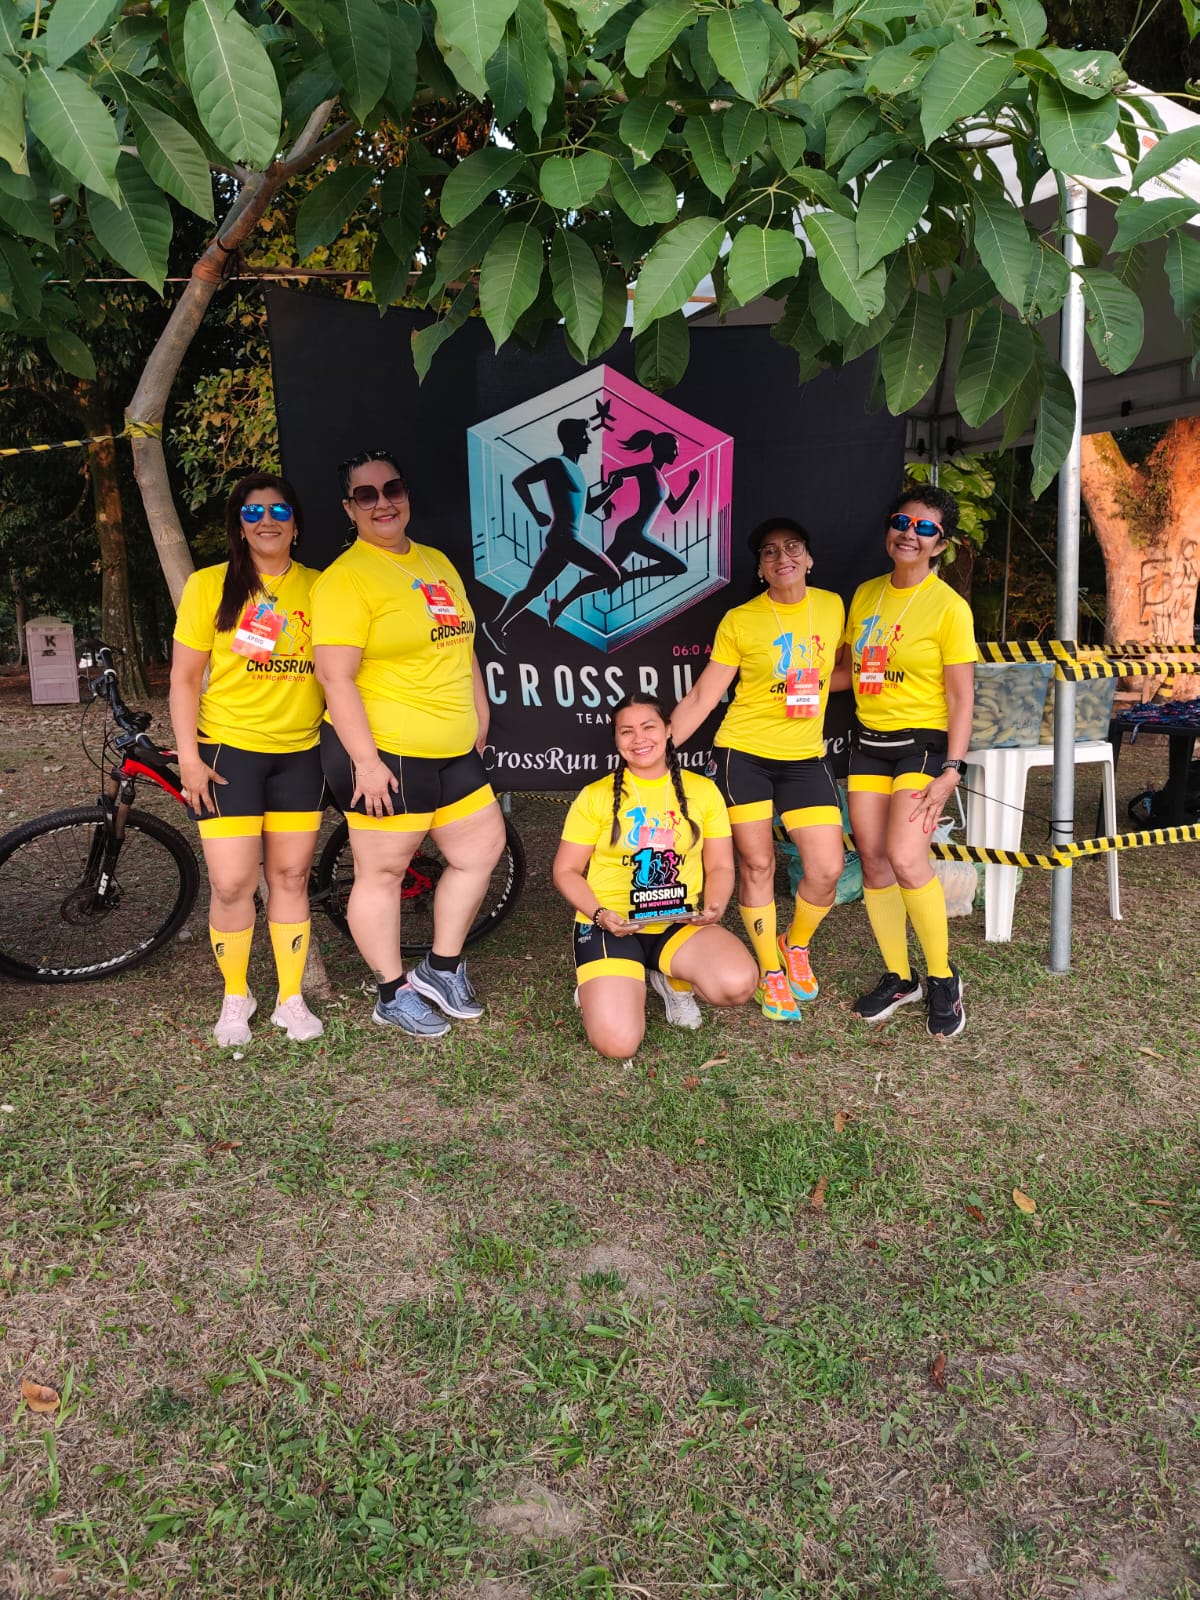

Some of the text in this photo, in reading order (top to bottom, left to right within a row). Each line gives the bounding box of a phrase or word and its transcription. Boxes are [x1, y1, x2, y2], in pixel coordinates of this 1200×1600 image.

[246, 659, 316, 675] CROSSRUN
[481, 745, 599, 775] CrossRun
[633, 886, 685, 903] CROSSRUN
